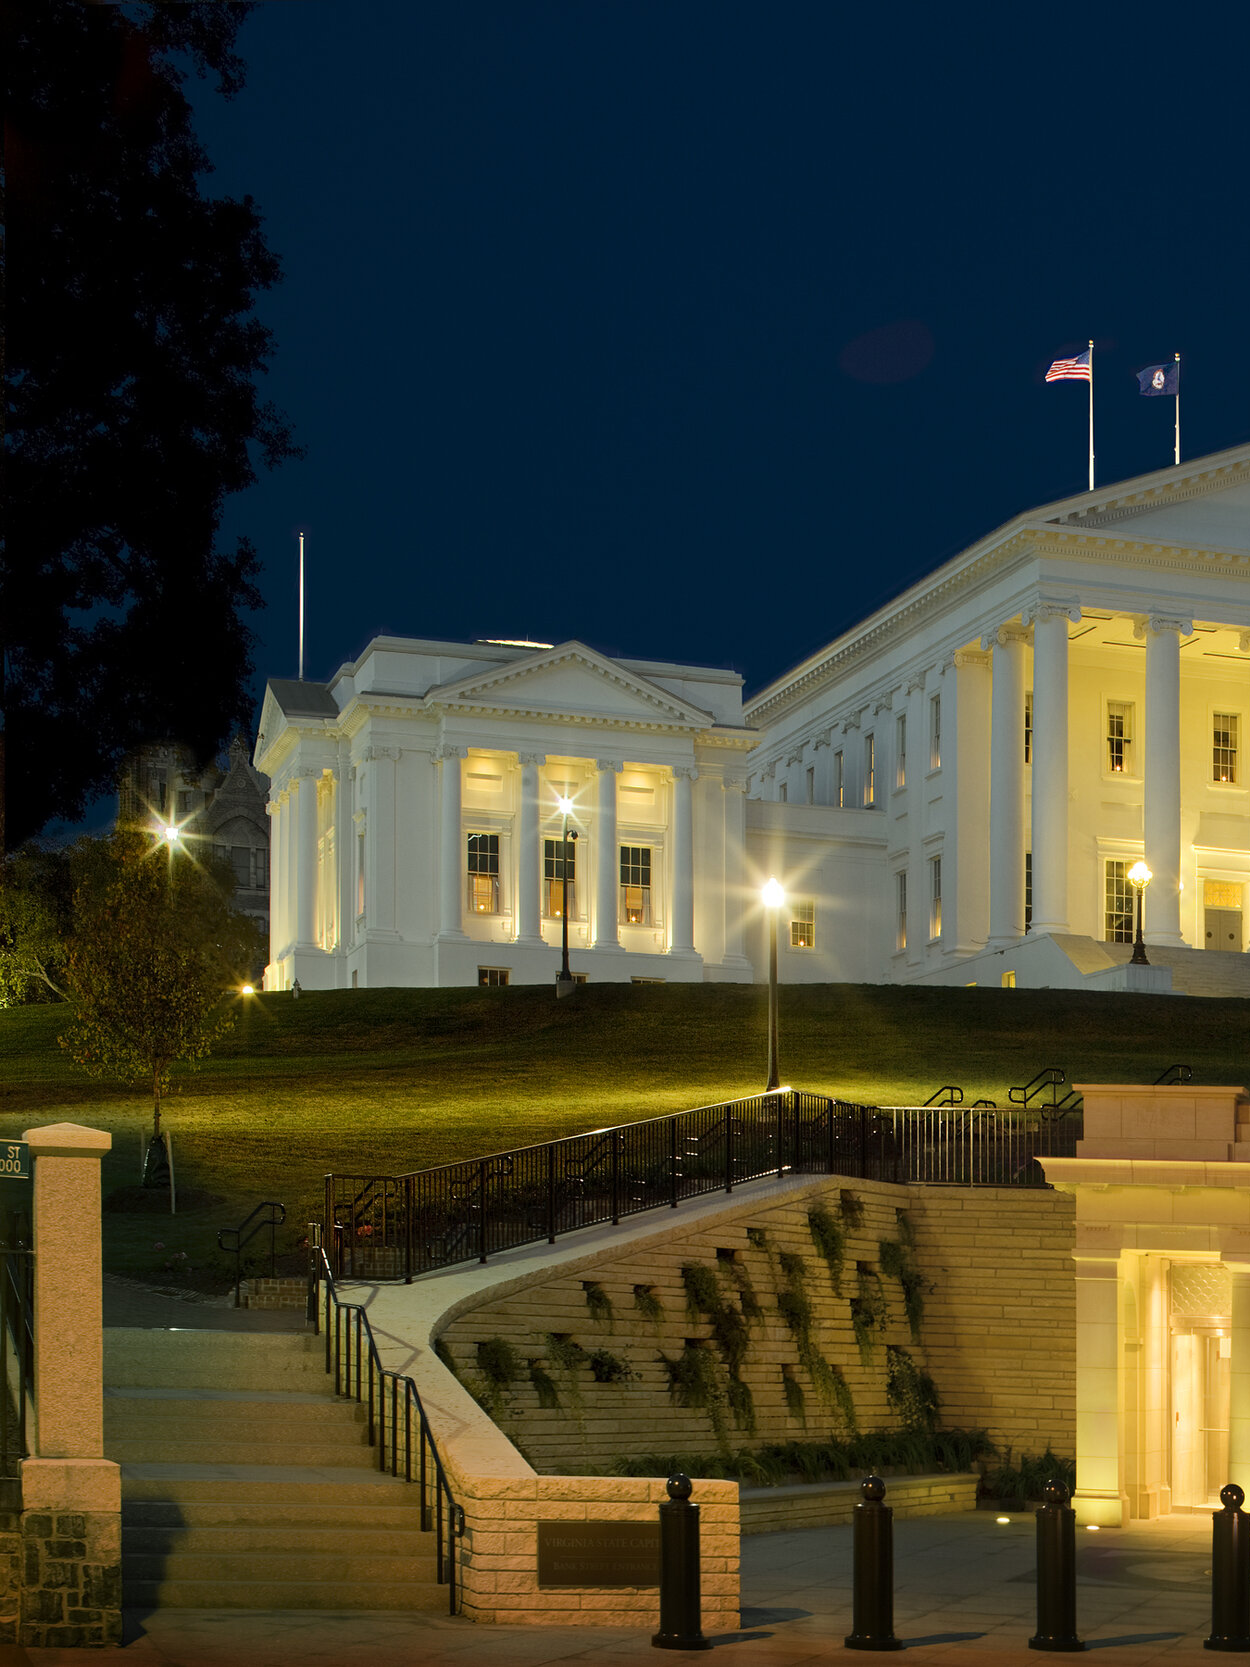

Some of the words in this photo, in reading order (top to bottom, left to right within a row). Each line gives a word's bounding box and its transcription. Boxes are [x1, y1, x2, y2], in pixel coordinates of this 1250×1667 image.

[8, 1146, 21, 1159] ST
[544, 1538, 595, 1548] VIRGINIA
[595, 1538, 628, 1548] STATE
